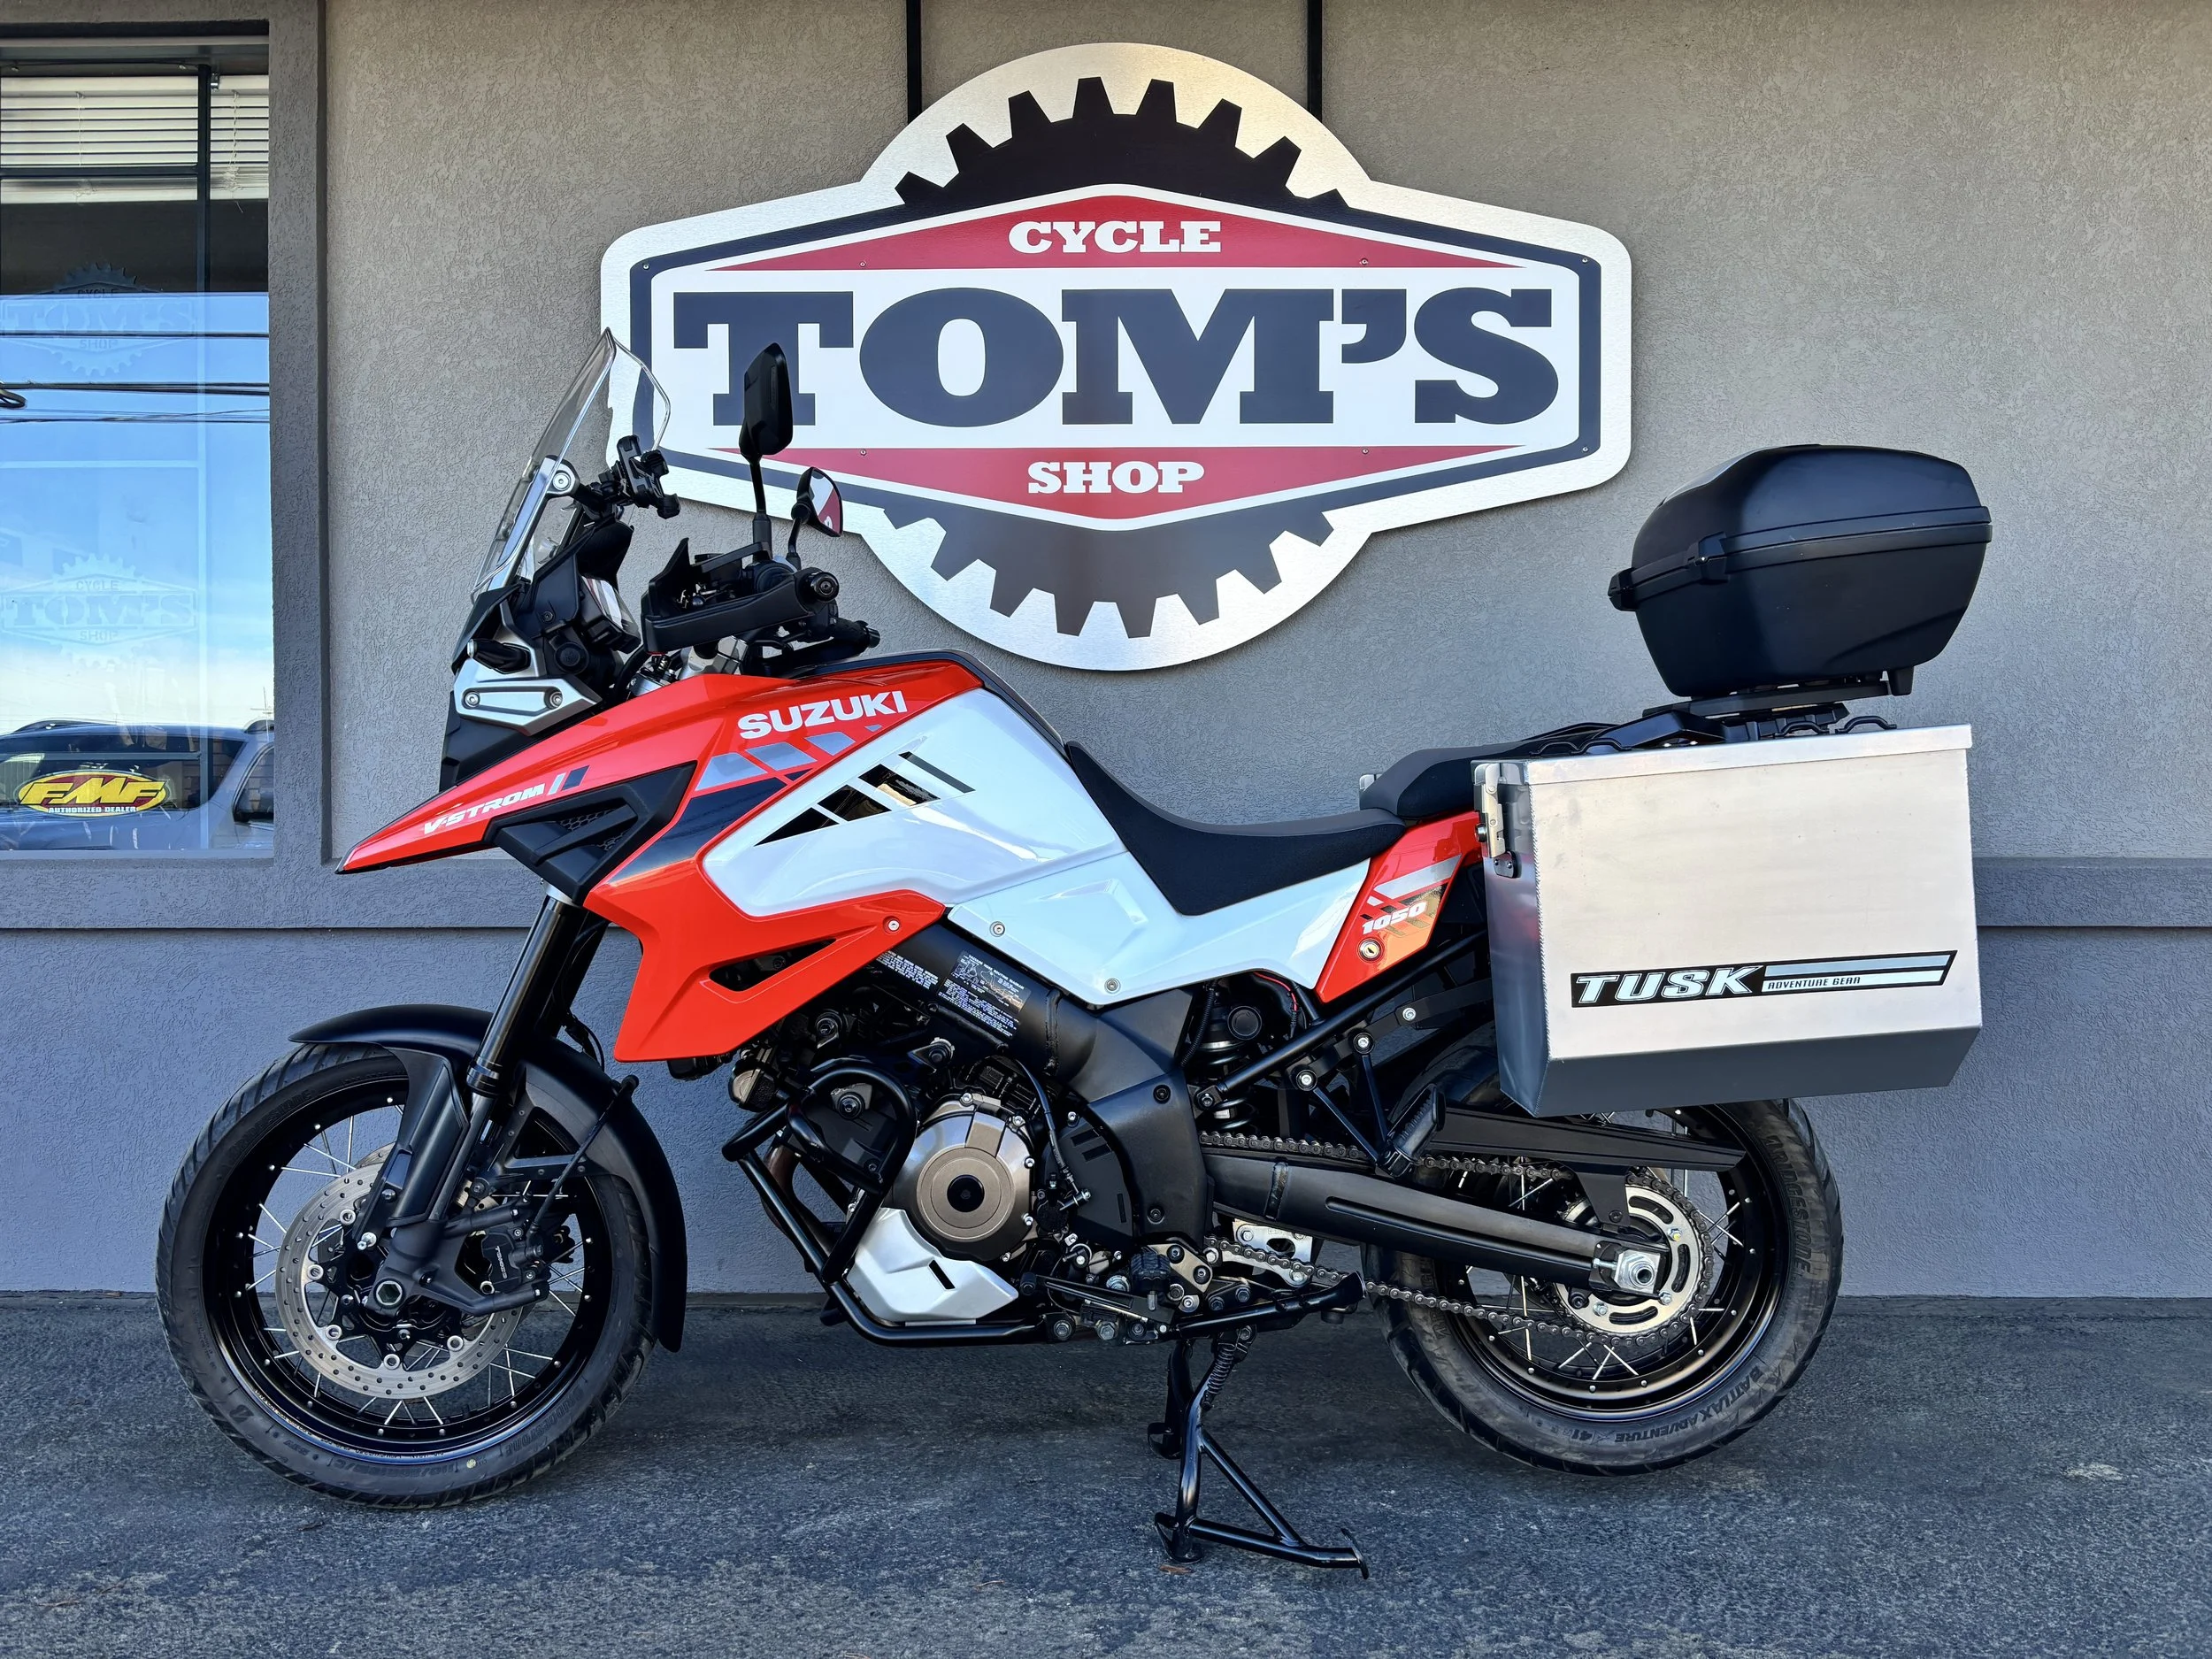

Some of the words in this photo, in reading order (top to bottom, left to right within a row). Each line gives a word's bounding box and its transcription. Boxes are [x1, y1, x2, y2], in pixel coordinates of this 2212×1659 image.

[1009, 220, 1221, 253] CYCLE
[80, 339, 118, 349] SHOP
[673, 287, 1558, 427] TOM'S
[1028, 461, 1204, 494] SHOP
[76, 580, 119, 591] CYCLE
[81, 631, 119, 641] SHOP
[738, 690, 908, 739] SUZUKI
[19, 777, 165, 805] FMF
[424, 783, 546, 834] V-STROM
[1363, 901, 1427, 934] 1050
[1576, 965, 1763, 1003] TUSK
[1768, 979, 1829, 989] ADVENTURE
[1765, 1135, 1812, 1274] BRIDGESTONE
[1701, 1365, 1764, 1423] BATTLAX
[1615, 1416, 1701, 1443] ADVENTURE
